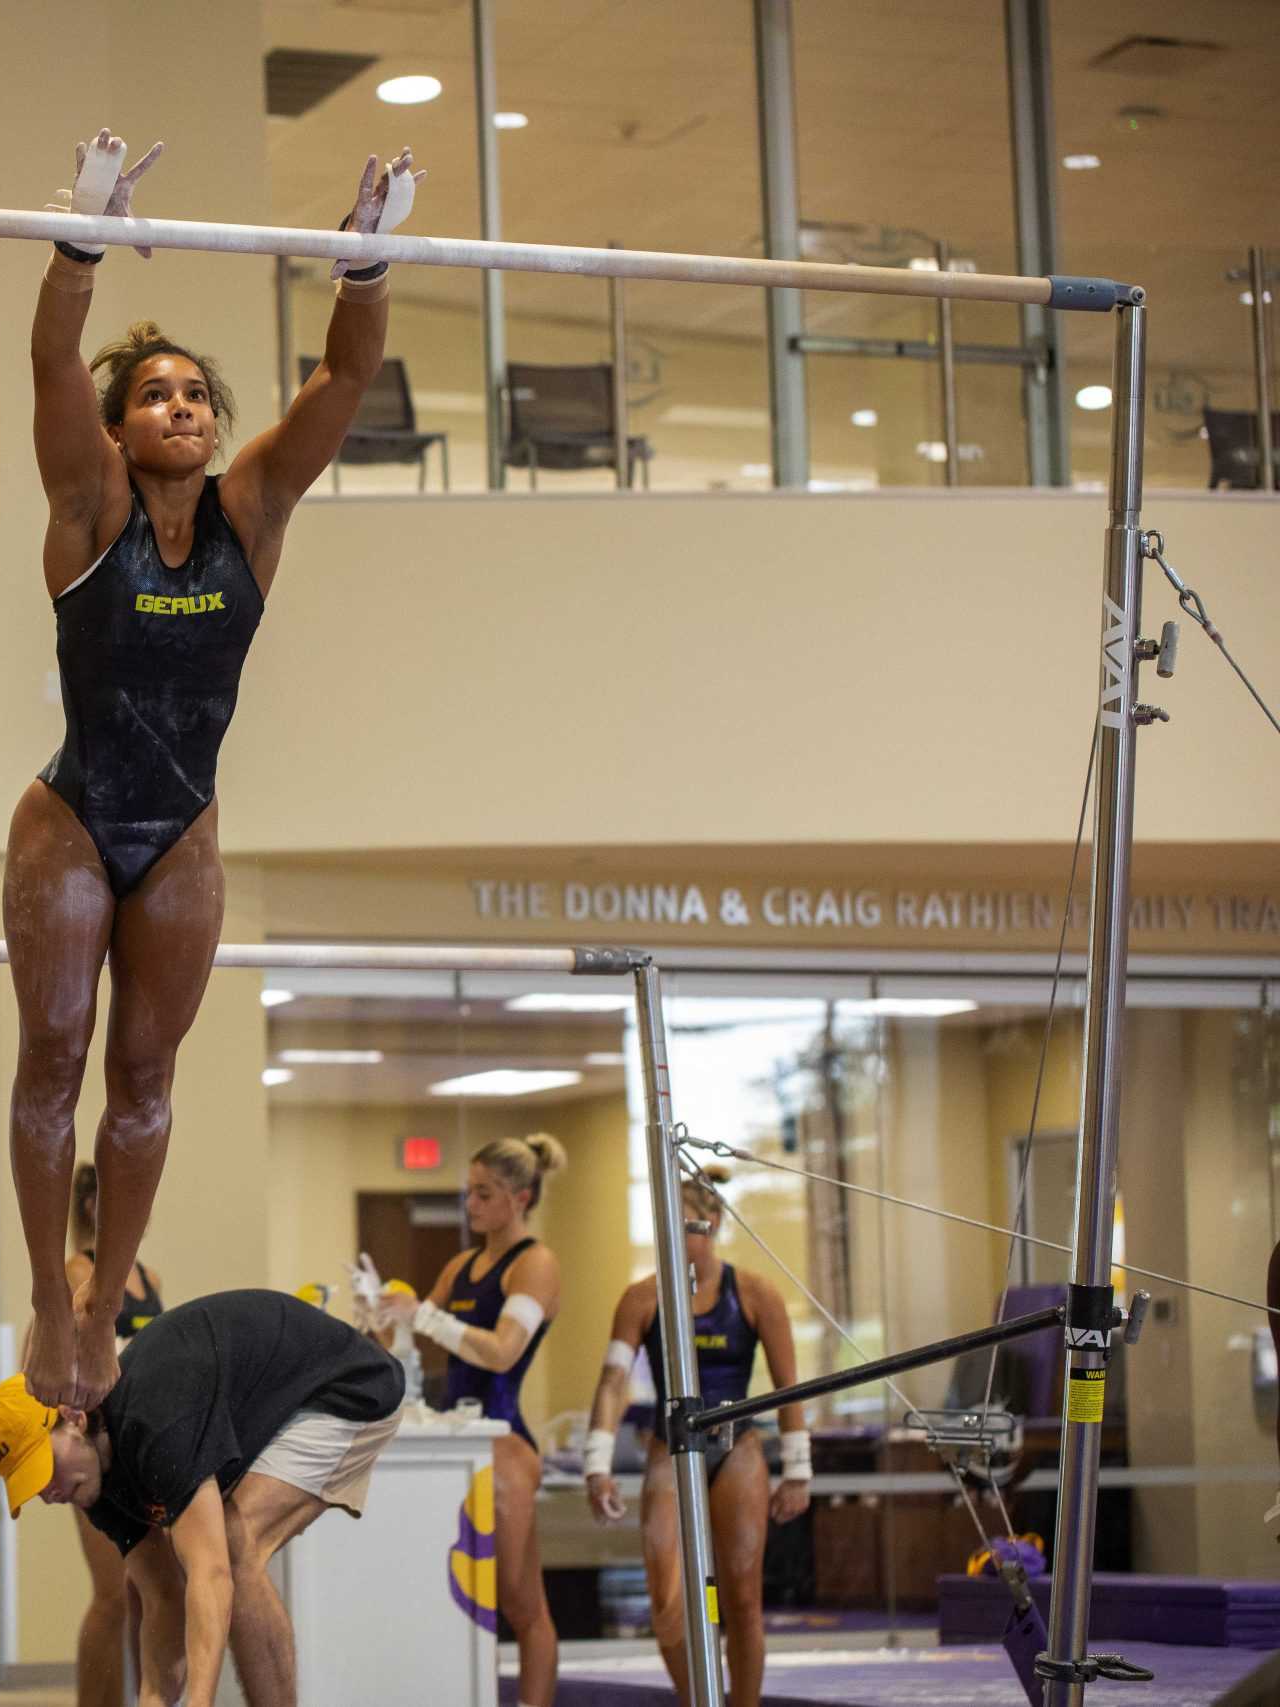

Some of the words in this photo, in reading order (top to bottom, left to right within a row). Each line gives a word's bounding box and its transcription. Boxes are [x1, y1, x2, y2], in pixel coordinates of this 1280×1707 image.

[135, 592, 226, 615] GEAUX
[472, 880, 549, 920] THE
[564, 880, 708, 925] DONNA
[719, 887, 749, 926] &
[762, 886, 881, 927] CRAIG
